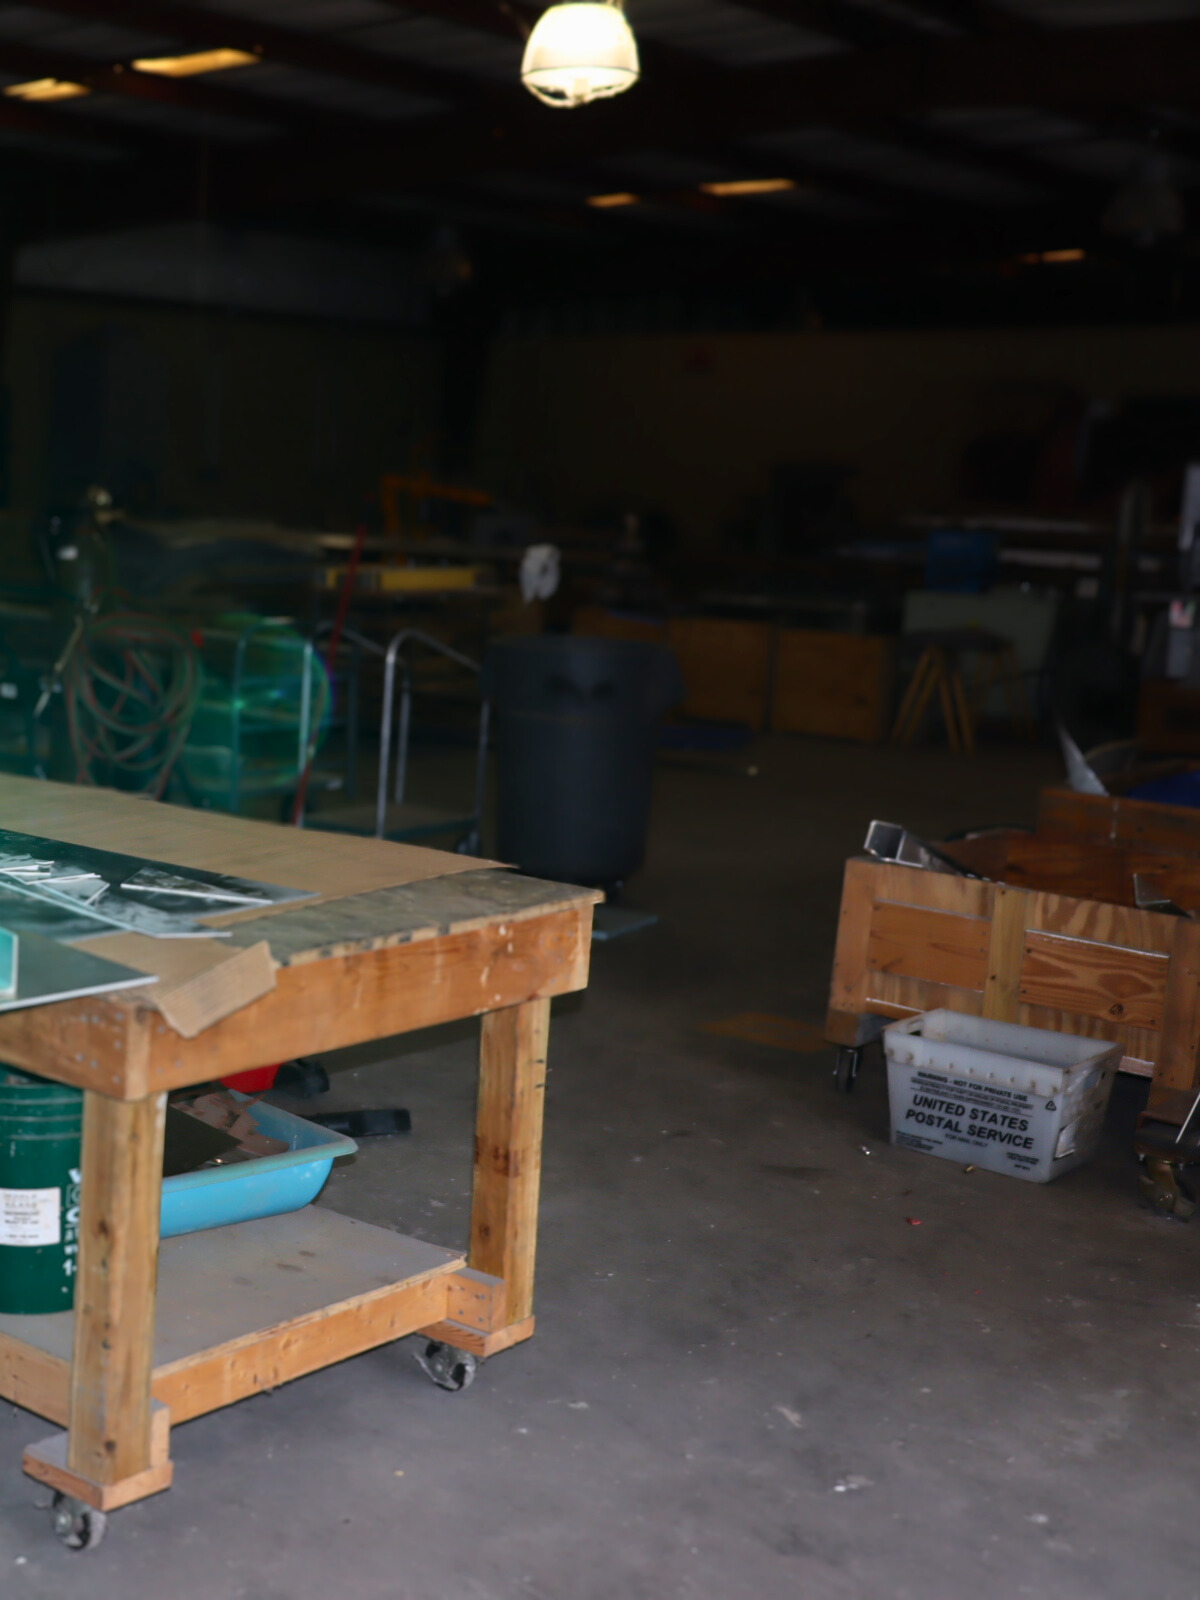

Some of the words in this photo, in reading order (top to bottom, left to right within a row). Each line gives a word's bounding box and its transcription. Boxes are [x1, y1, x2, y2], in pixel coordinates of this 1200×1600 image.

[969, 1082, 983, 1091] FOR
[984, 1086, 1012, 1098] PRIVATE
[905, 1108, 962, 1133] POSTAL
[967, 1124, 1034, 1150] SERVICE
[912, 1094, 966, 1116] UNITED
[969, 1108, 1029, 1132] STATES
